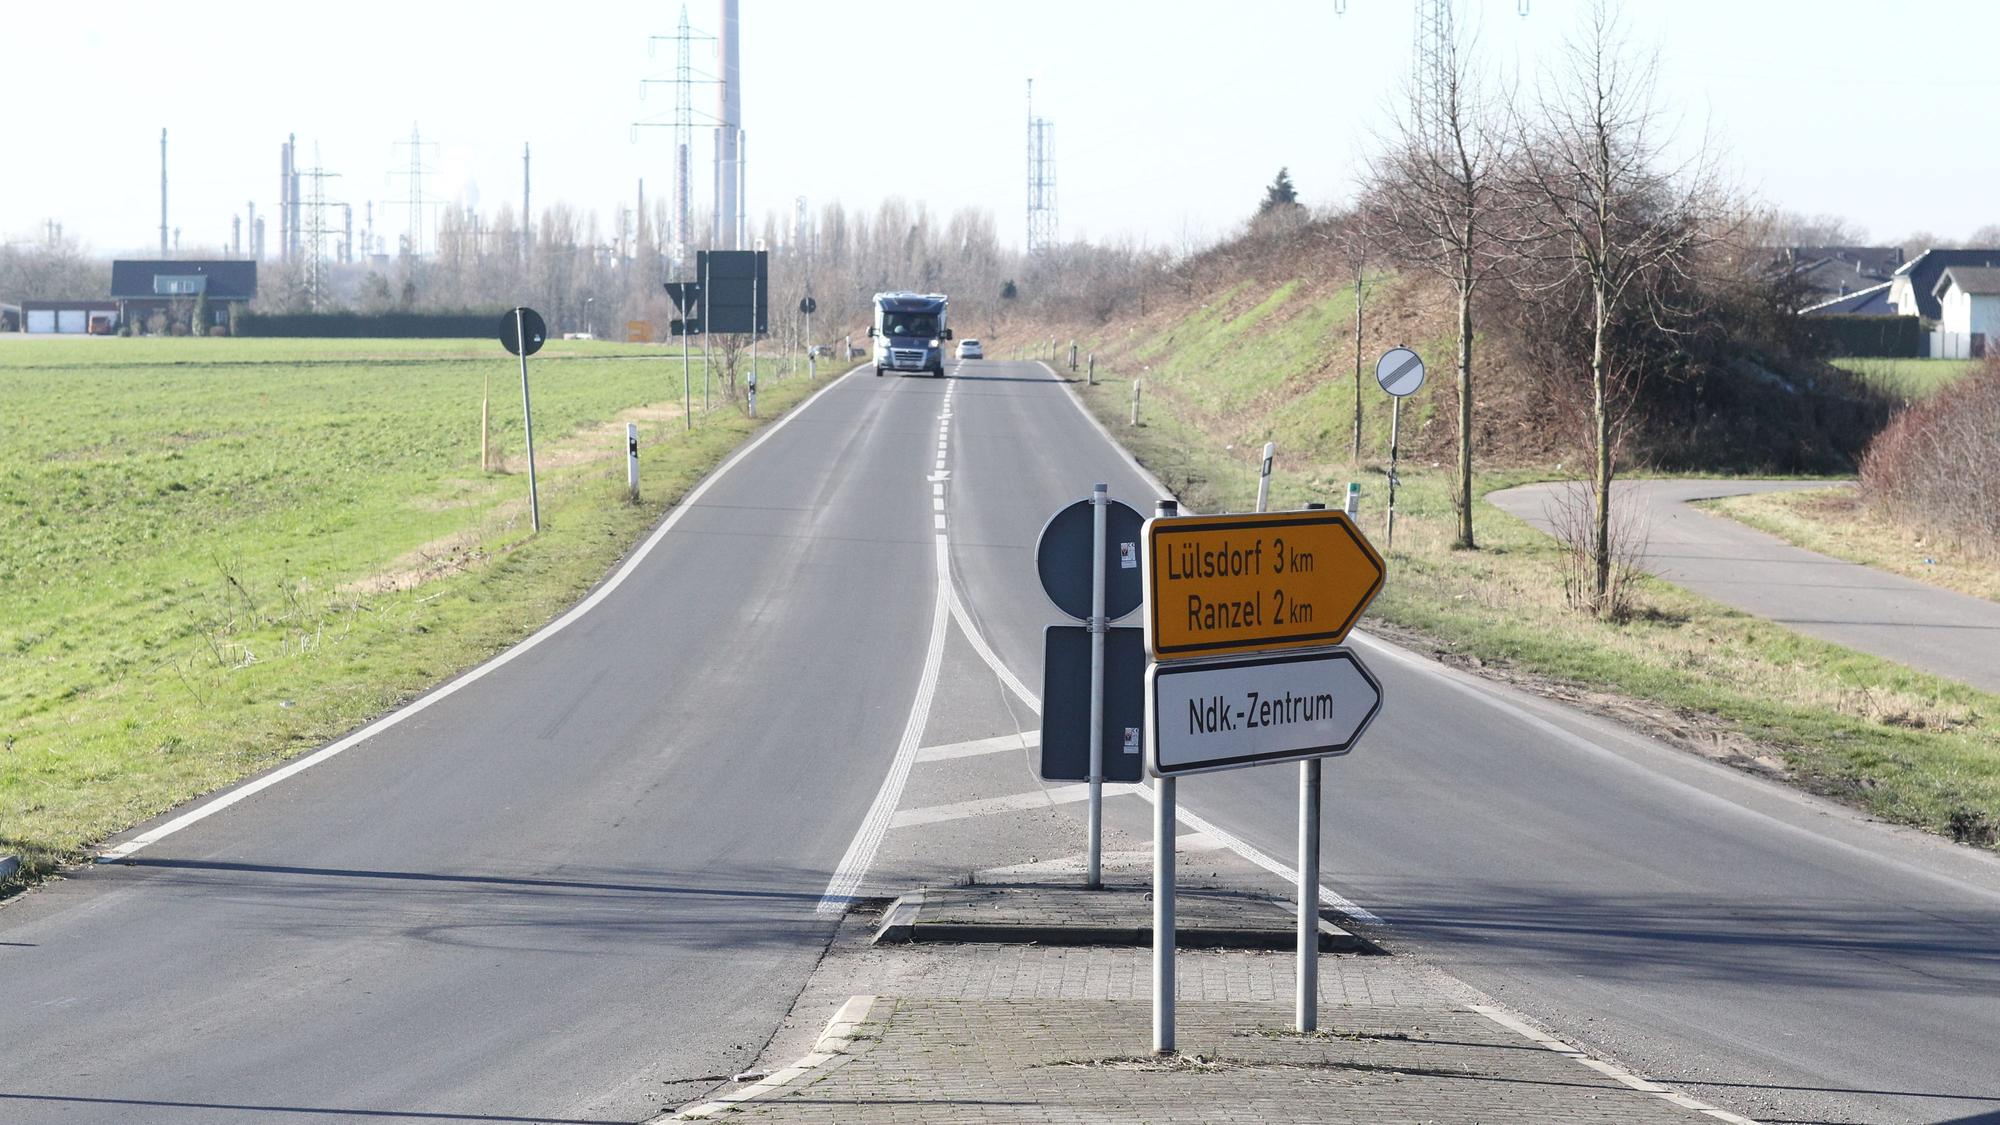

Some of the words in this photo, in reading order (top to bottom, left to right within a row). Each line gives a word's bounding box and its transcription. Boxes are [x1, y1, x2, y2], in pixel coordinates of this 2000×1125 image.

[1168, 539, 1262, 580] Lülsdorf
[1273, 538, 1284, 574] 3
[1290, 547, 1314, 573] km
[1188, 591, 1262, 631] Ranzel
[1273, 589, 1284, 625] 2
[1290, 597, 1313, 623] km
[1189, 691, 1333, 735] Ndk.-Zentrum
